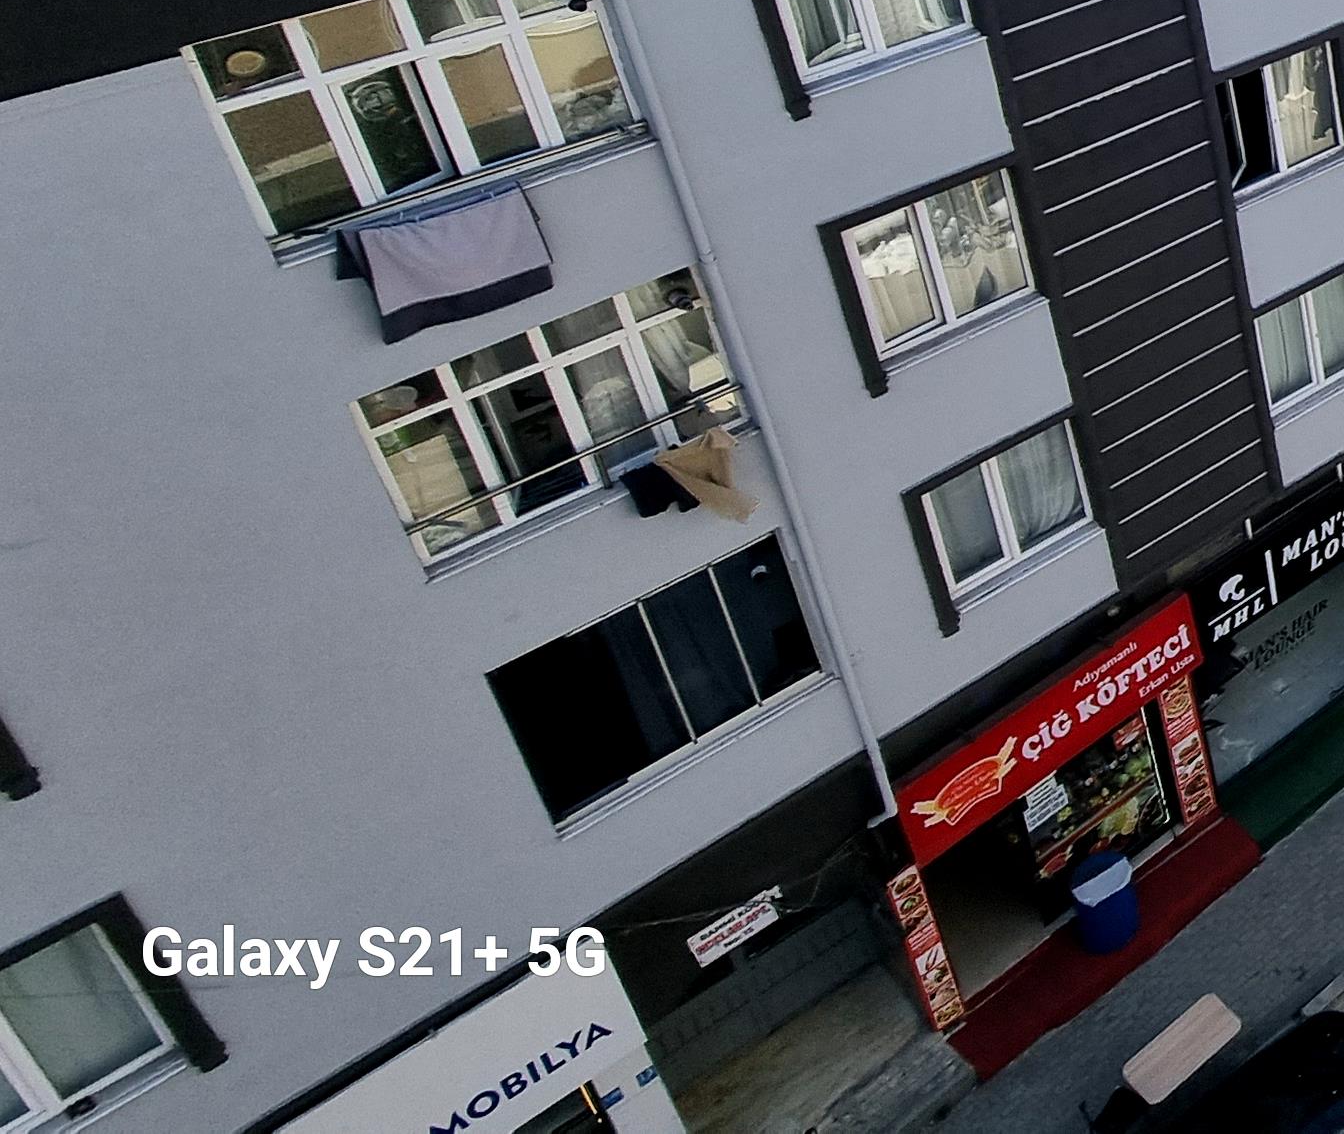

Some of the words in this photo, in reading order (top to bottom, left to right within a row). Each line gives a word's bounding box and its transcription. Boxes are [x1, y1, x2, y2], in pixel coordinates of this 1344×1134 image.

[1213, 597, 1265, 643] MHL
[1021, 709, 1073, 763] ÇİĞ
[1076, 623, 1192, 723] KÖFTECİ
[1138, 673, 1169, 699] Erkan
[1170, 653, 1196, 676] Usta
